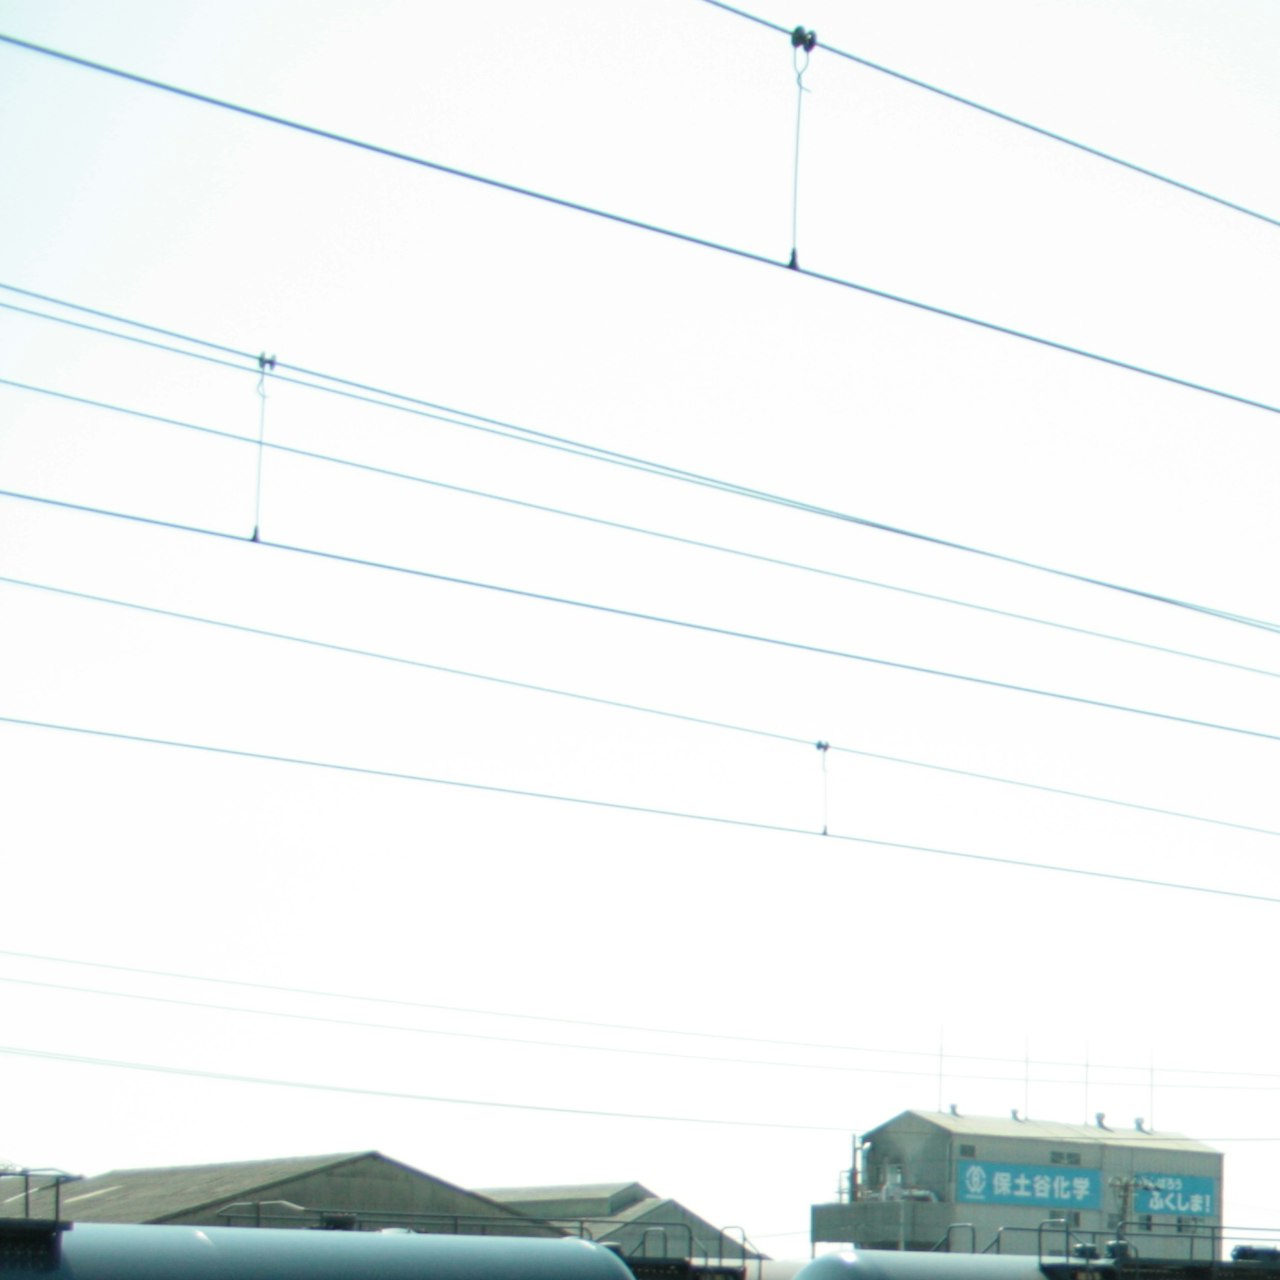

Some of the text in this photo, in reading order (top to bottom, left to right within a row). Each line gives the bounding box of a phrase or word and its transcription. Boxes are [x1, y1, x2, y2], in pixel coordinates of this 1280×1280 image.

[993, 1171, 1090, 1200] 保土谷化学
